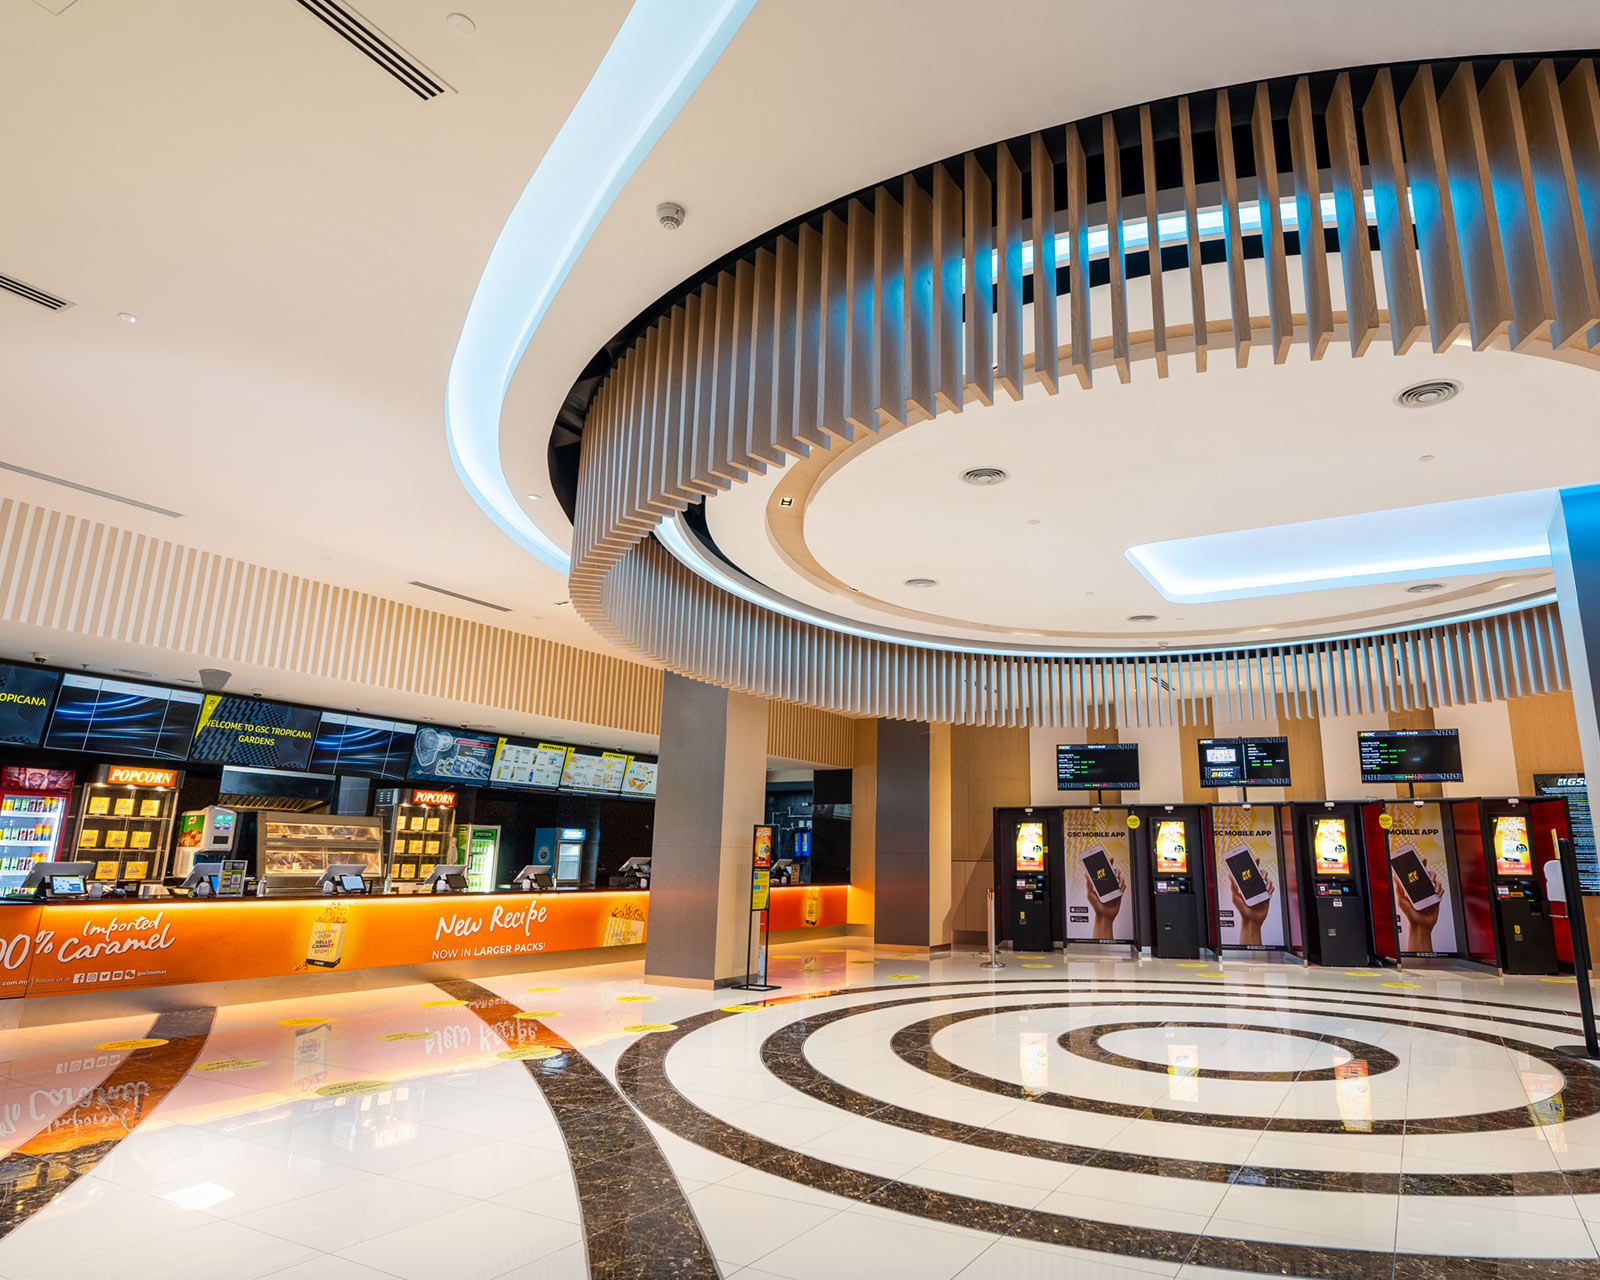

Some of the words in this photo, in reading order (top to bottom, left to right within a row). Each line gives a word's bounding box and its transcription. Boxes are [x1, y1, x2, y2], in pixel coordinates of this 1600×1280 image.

[0, 692, 46, 706] OPICANA
[244, 723, 254, 732] TO
[255, 725, 270, 734] GSC
[271, 727, 312, 739] TROPICANA
[238, 735, 275, 746] GARDENS
[110, 768, 174, 785] POPCORN
[1567, 778, 1587, 786] GS
[414, 791, 455, 804] POPCORN
[83, 912, 164, 942] Imported
[435, 914, 482, 941] New
[489, 900, 548, 937] Recipe
[57, 923, 176, 963] Caramel
[432, 950, 458, 960] NOW
[460, 948, 471, 957] IN
[474, 945, 512, 956] LARGER
[514, 942, 546, 953] PACKS!
